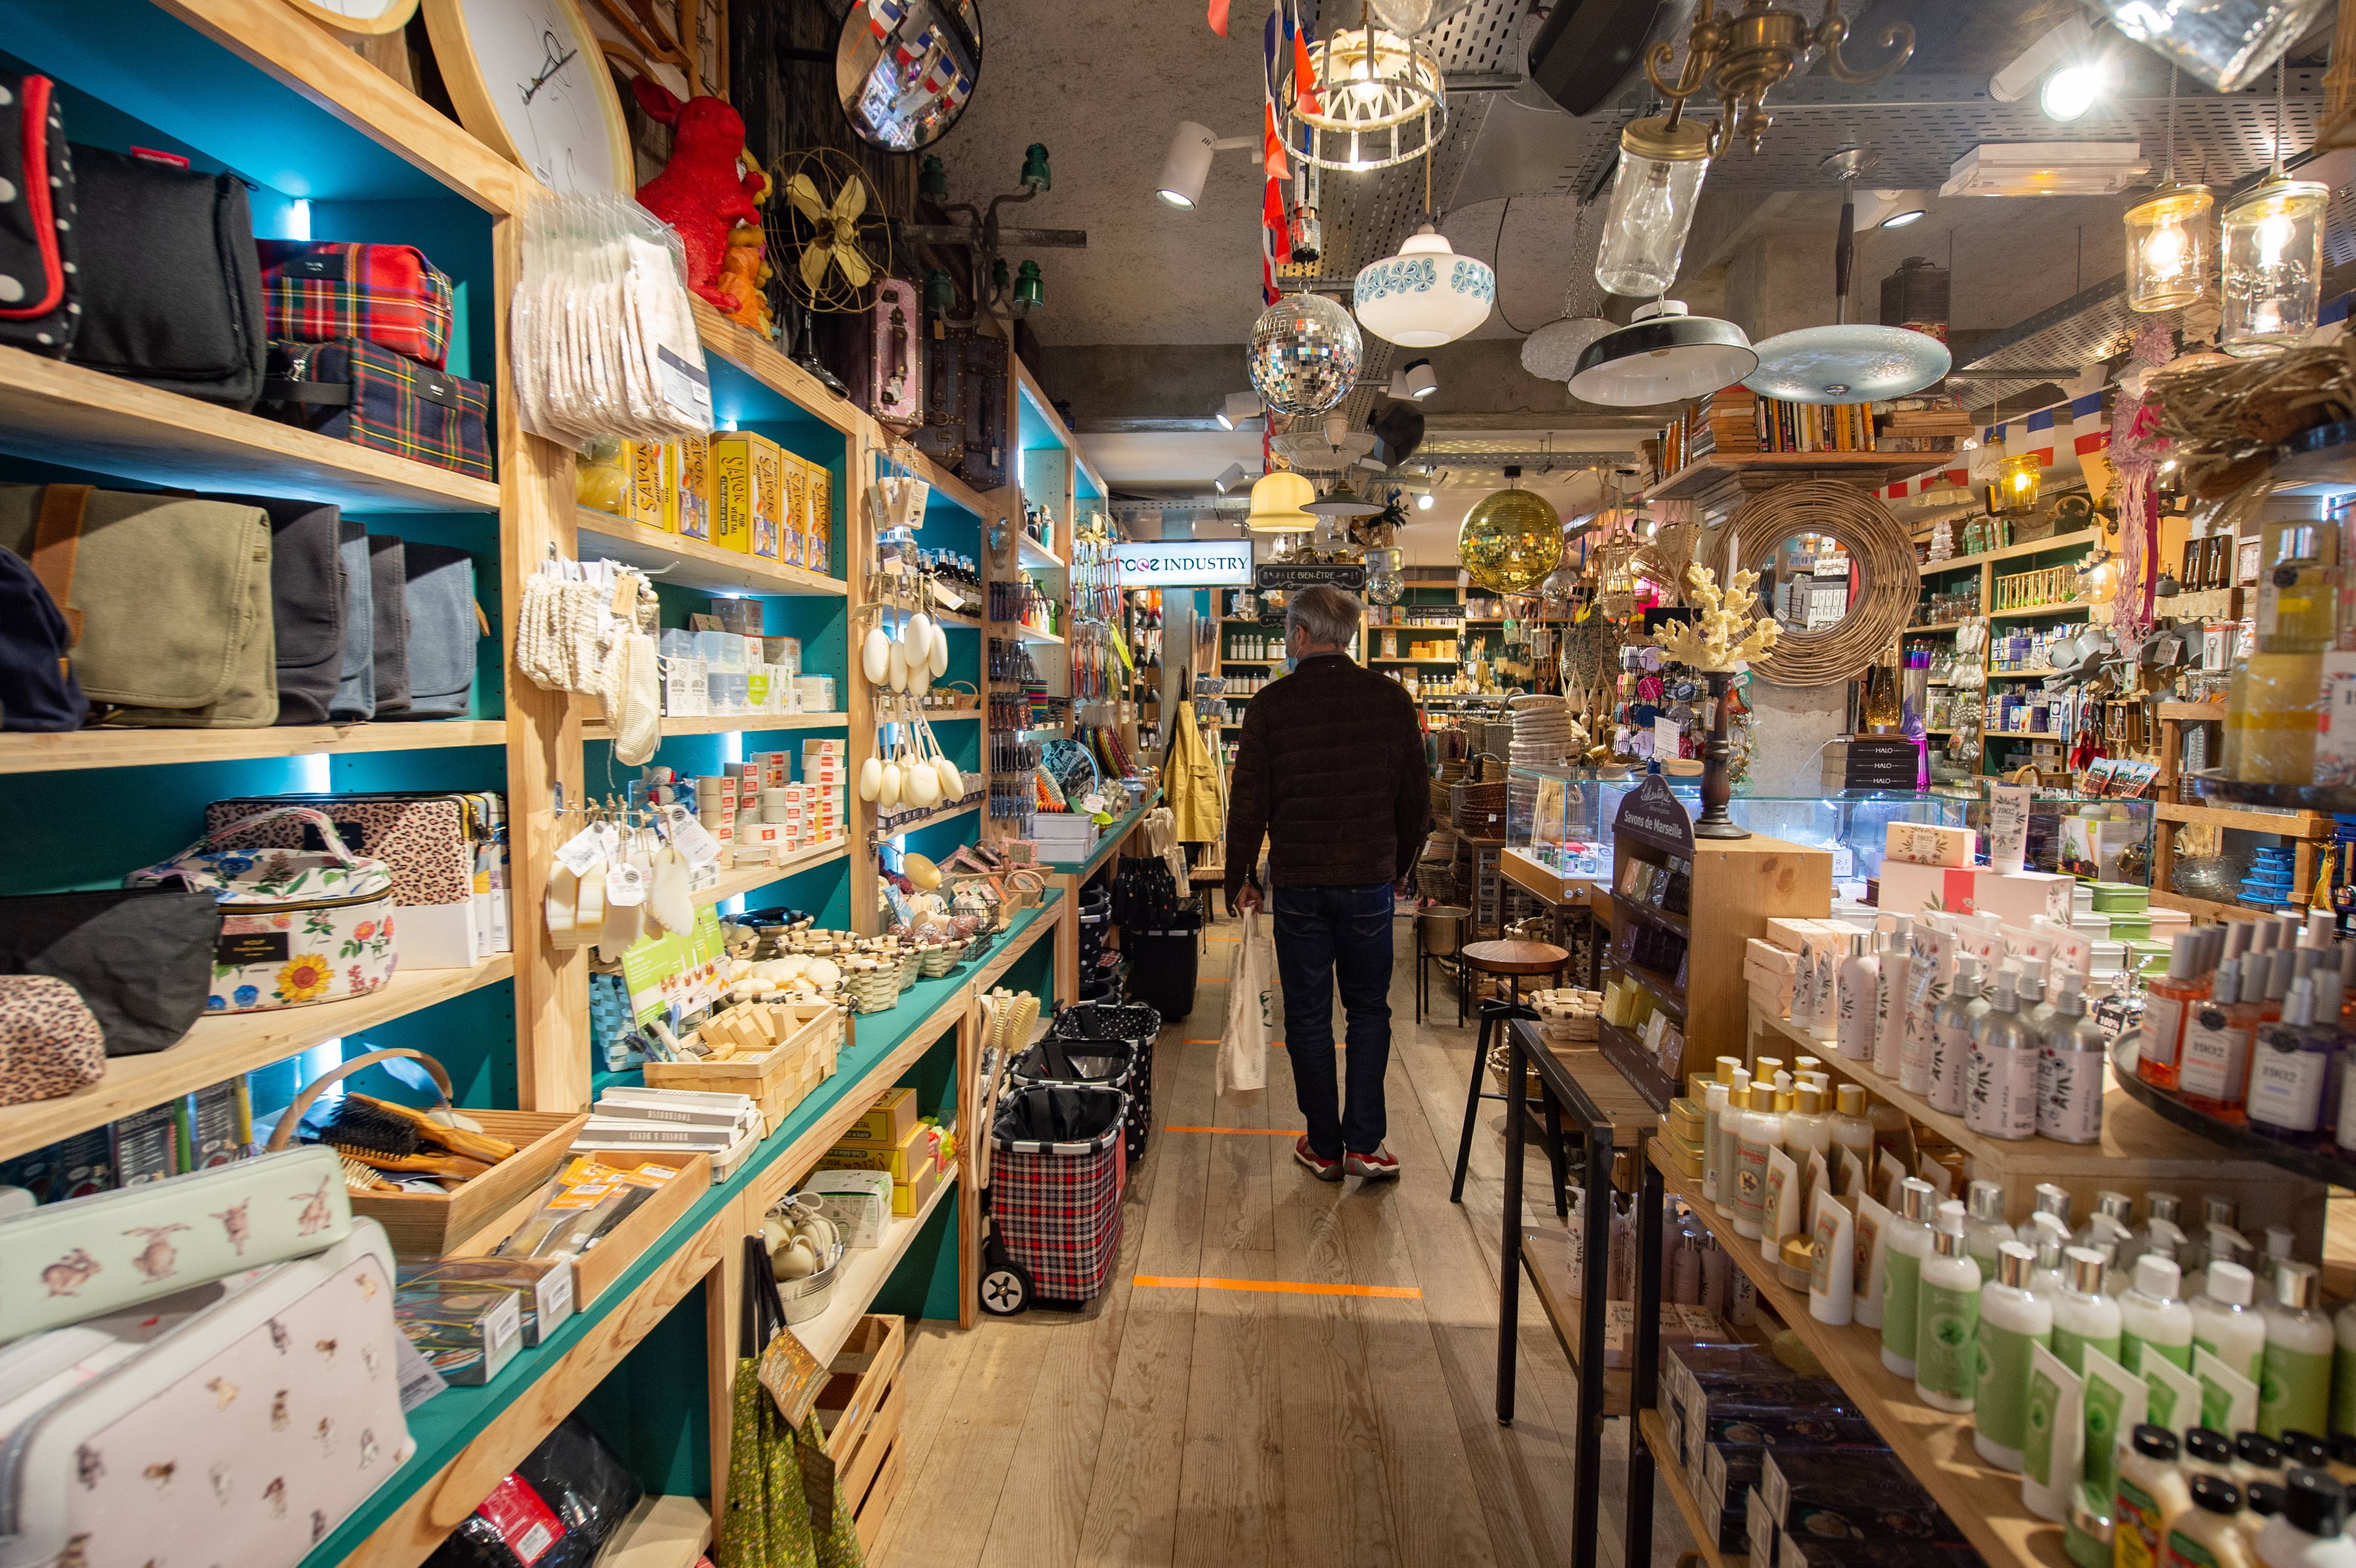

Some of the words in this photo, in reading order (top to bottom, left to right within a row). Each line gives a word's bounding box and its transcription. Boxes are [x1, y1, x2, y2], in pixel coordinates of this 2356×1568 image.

[691, 434, 703, 490] AVON
[721, 457, 746, 504] SAVON
[759, 456, 775, 513] SAVON
[789, 471, 802, 525] SAVON
[815, 482, 827, 534] SAVON
[1164, 557, 1248, 570] INDUSTRY
[1297, 571, 1334, 579] BIEN-ÊTRE
[1998, 807, 2015, 815] 1902
[1624, 810, 1644, 827] Savons
[1645, 816, 1653, 830] de
[1654, 819, 1682, 839] Marseille
[1917, 834, 1933, 843] 1902
[2100, 1015, 2120, 1029] 100%
[648, 1110, 691, 1122] TOOTHBRUSH
[629, 1131, 651, 1141] DENTS
[662, 1132, 688, 1141] BROSSE
